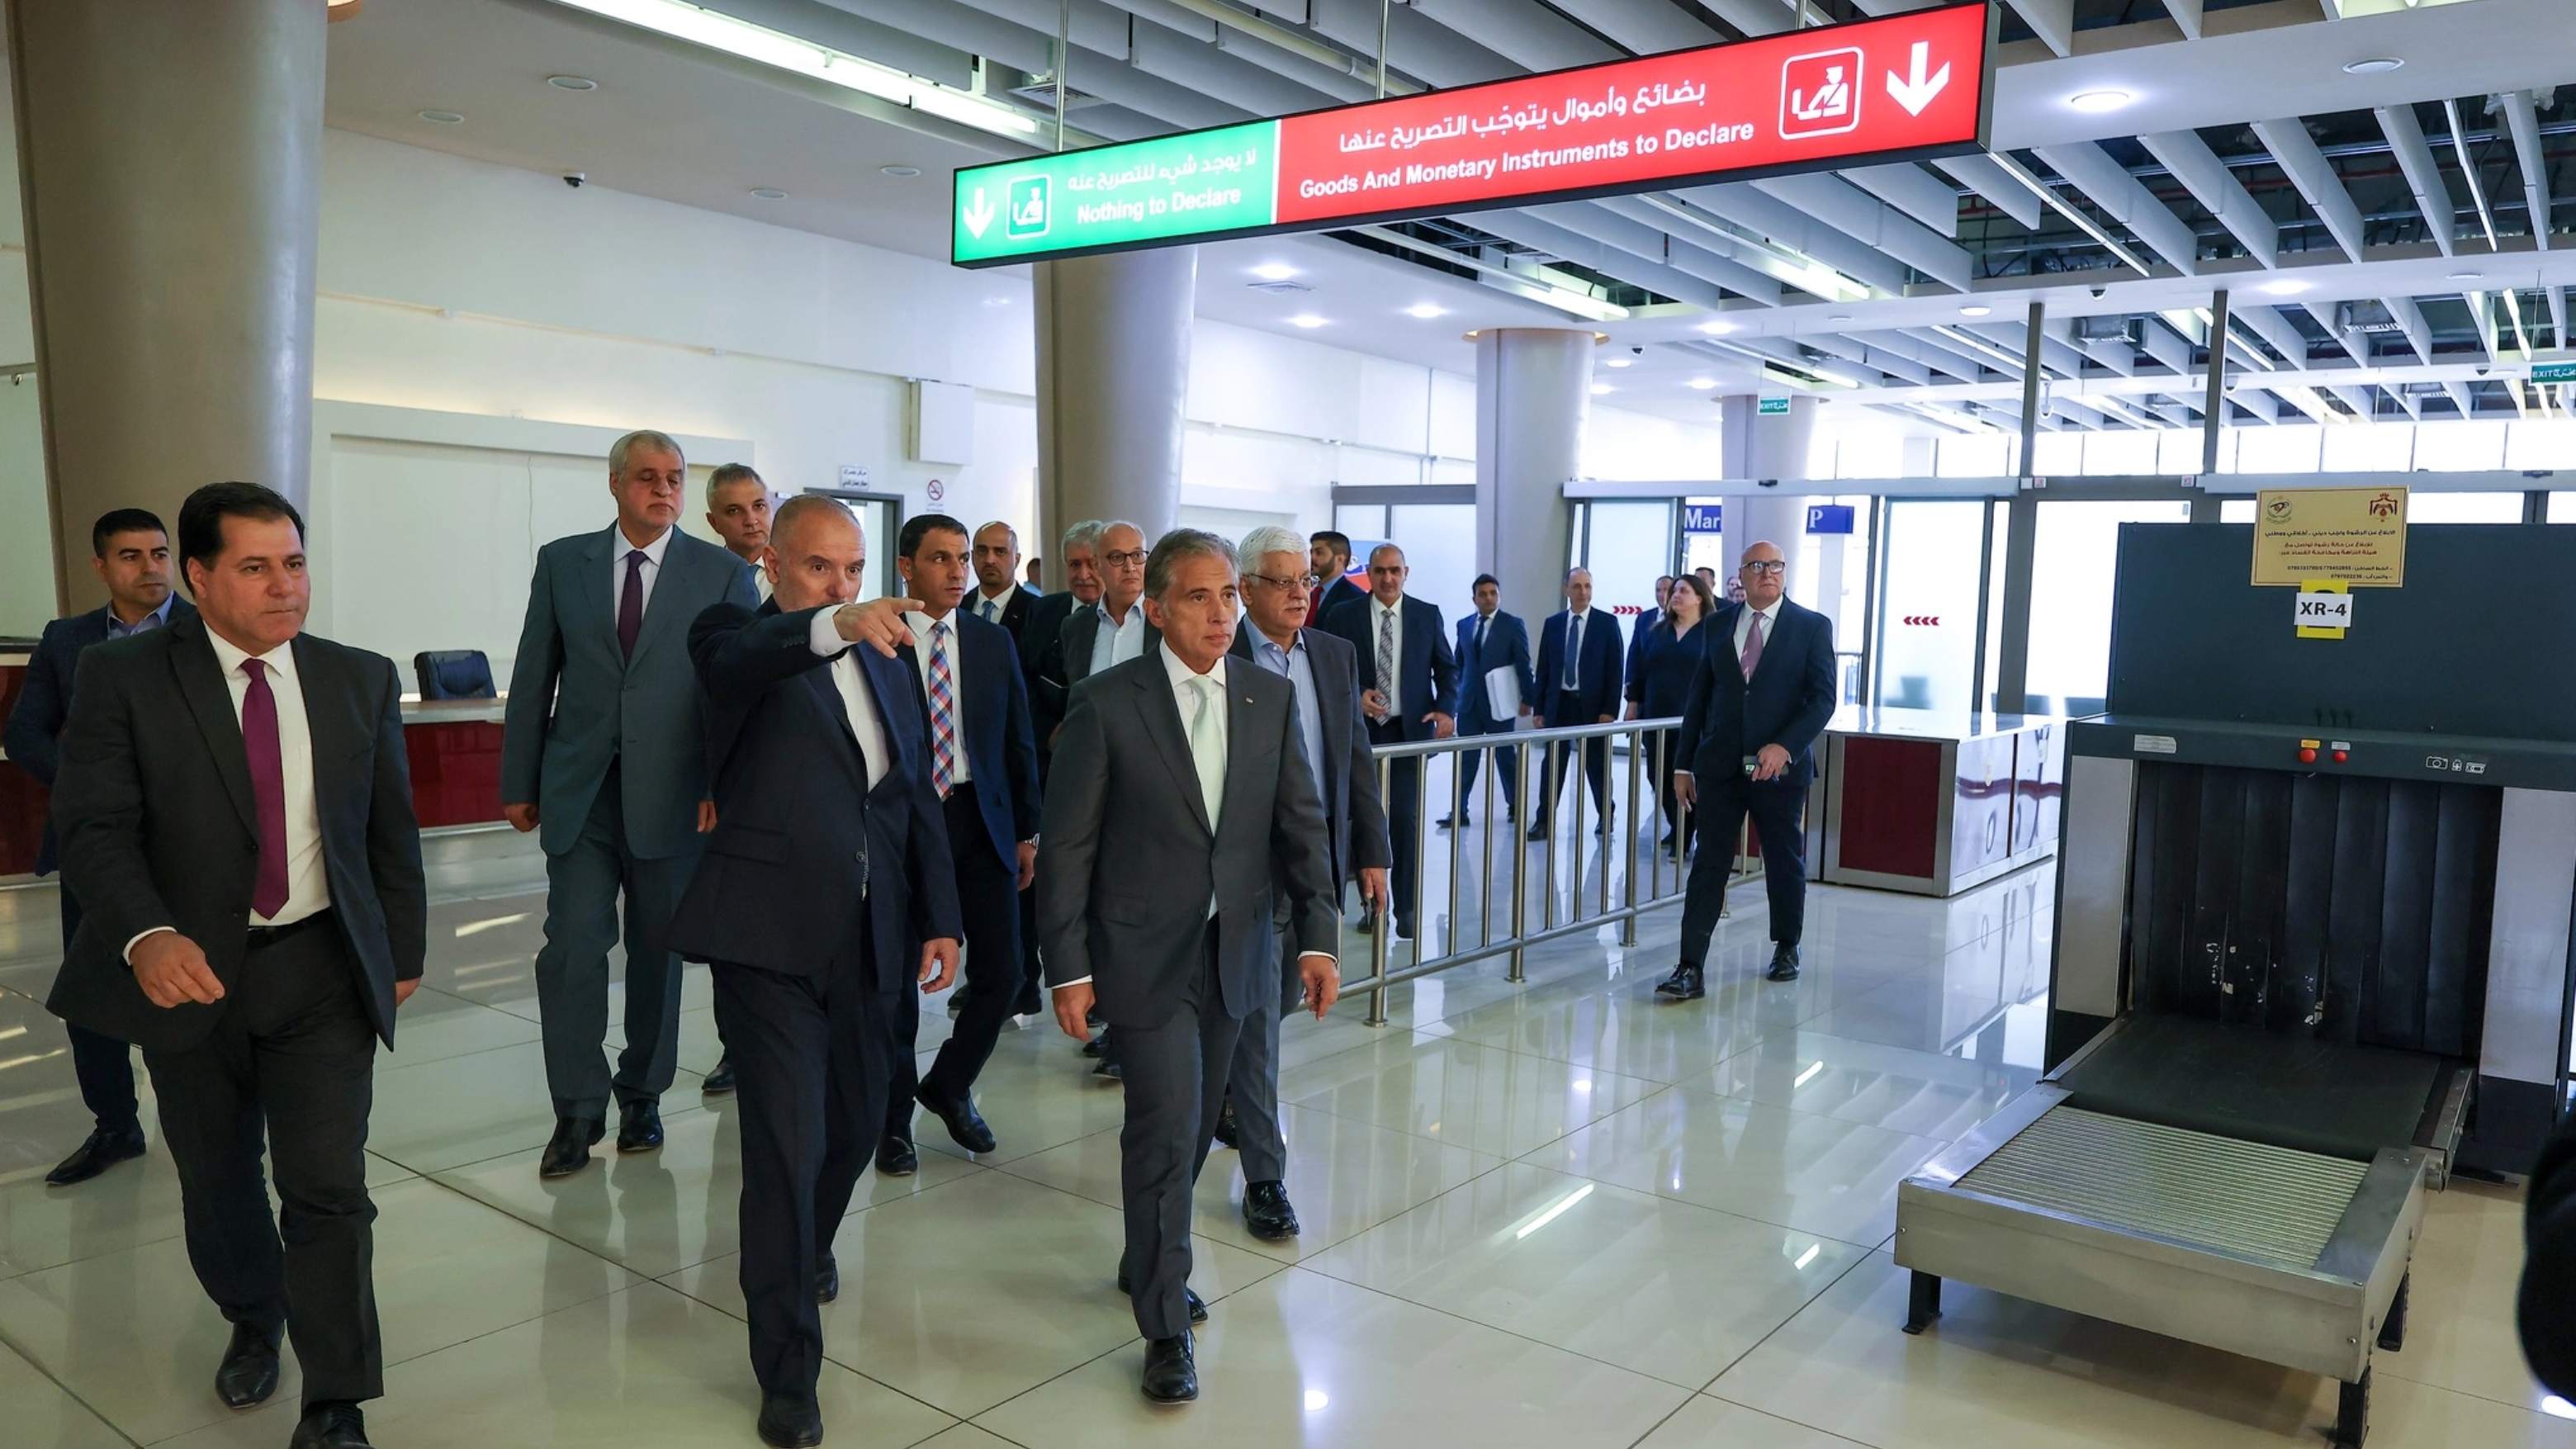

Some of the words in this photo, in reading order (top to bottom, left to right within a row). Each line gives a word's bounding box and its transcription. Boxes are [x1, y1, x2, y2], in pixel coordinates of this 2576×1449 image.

[1552, 86, 1627, 125] وأموال
[1632, 80, 1707, 114] بضائع
[1339, 130, 1386, 153] عنها
[1390, 115, 1467, 149] التصريح
[1158, 154, 1196, 185] شيء
[1200, 155, 1242, 176] يوجد
[1246, 148, 1257, 165] لا
[1300, 174, 1359, 198] Goods
[1361, 167, 1401, 191] And
[1405, 157, 1497, 185] Monetary
[1502, 138, 1630, 173] Instruments
[1635, 135, 1659, 154] to
[1664, 122, 1754, 151] Declare
[1067, 172, 1096, 192] عنه
[1096, 163, 1155, 192] للتصريح
[1077, 199, 1144, 225] Nothing
[1149, 198, 1167, 214] to
[1172, 188, 1241, 212] Declare
[1683, 507, 1721, 529] Mar
[1808, 508, 1824, 529] P
[2299, 601, 2347, 617] XR-4
